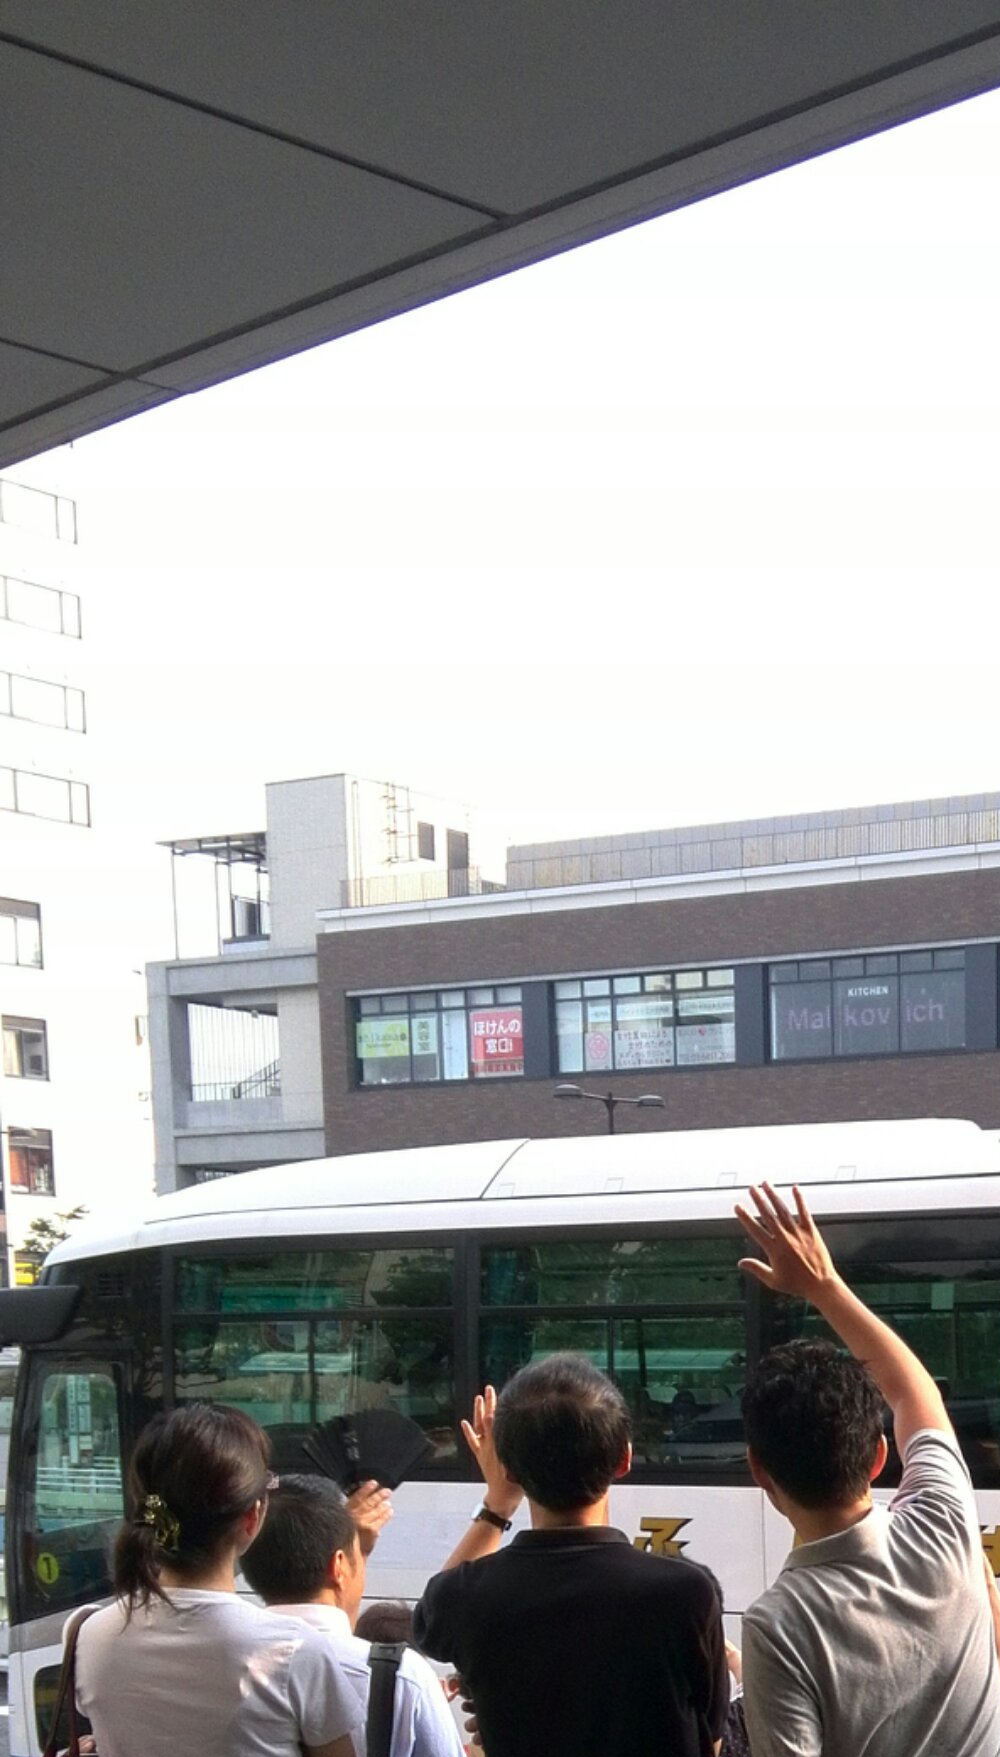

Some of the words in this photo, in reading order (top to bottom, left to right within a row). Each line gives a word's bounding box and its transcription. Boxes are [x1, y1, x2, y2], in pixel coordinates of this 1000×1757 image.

[847, 986, 889, 997] KITCHEN
[787, 998, 944, 1030] Malkovich
[474, 1019, 521, 1035] ほけんの
